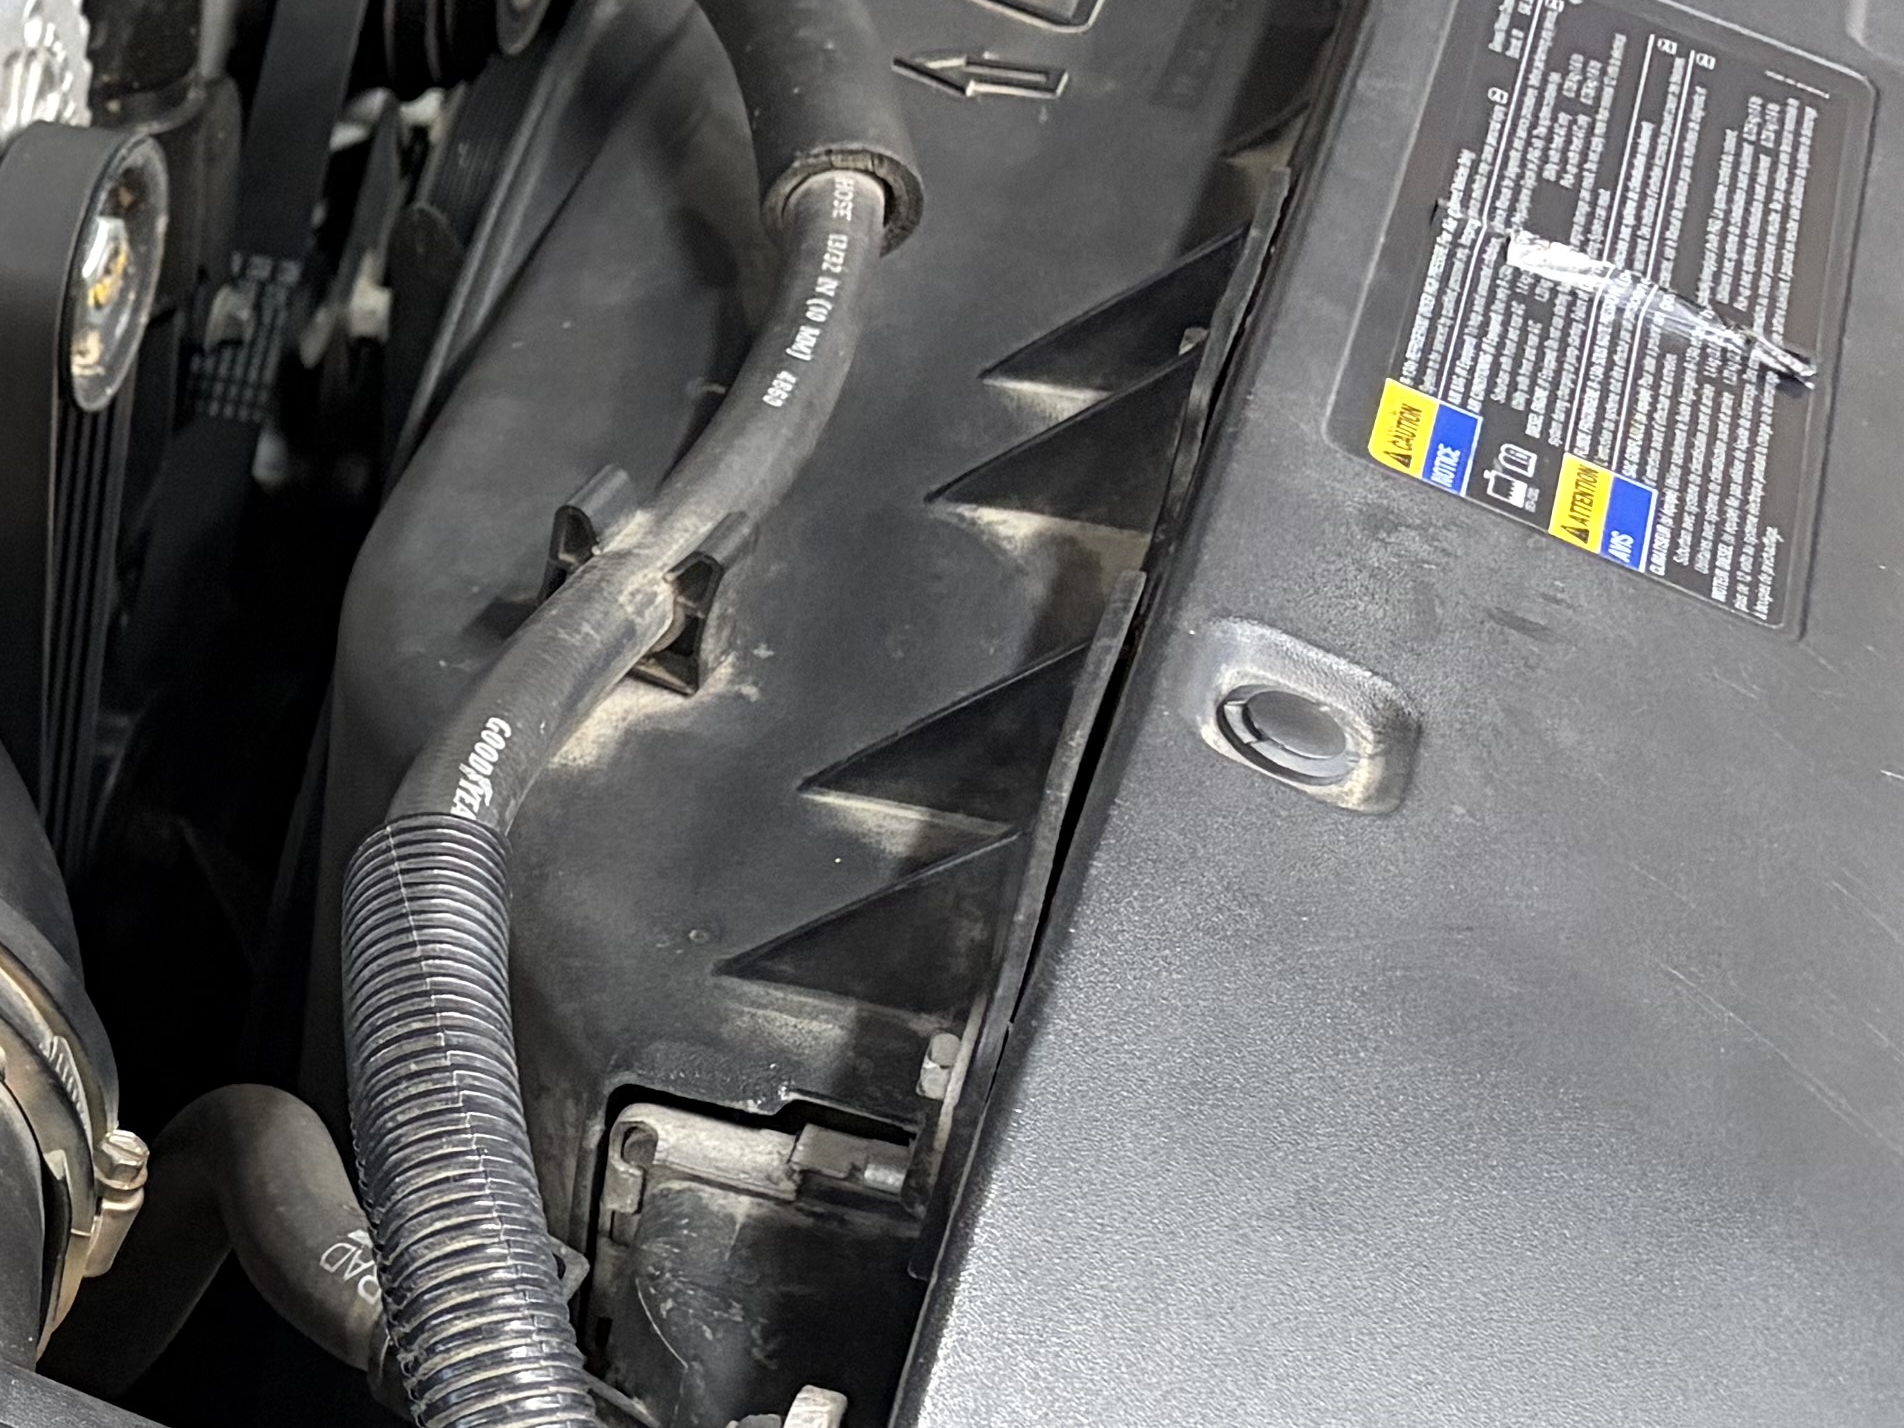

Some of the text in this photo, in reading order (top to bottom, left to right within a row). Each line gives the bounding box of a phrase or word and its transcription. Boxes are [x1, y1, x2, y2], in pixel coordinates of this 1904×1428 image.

[833, 176, 854, 222] HOSE
[822, 233, 848, 273] 13/32
[815, 276, 839, 297] IN
[1389, 402, 1423, 453] CAUTION
[1429, 441, 1461, 488] NOTICE
[1568, 463, 1600, 527] ATTENTION
[1607, 528, 1635, 563] AVIS
[451, 717, 511, 822] GOODYEA
